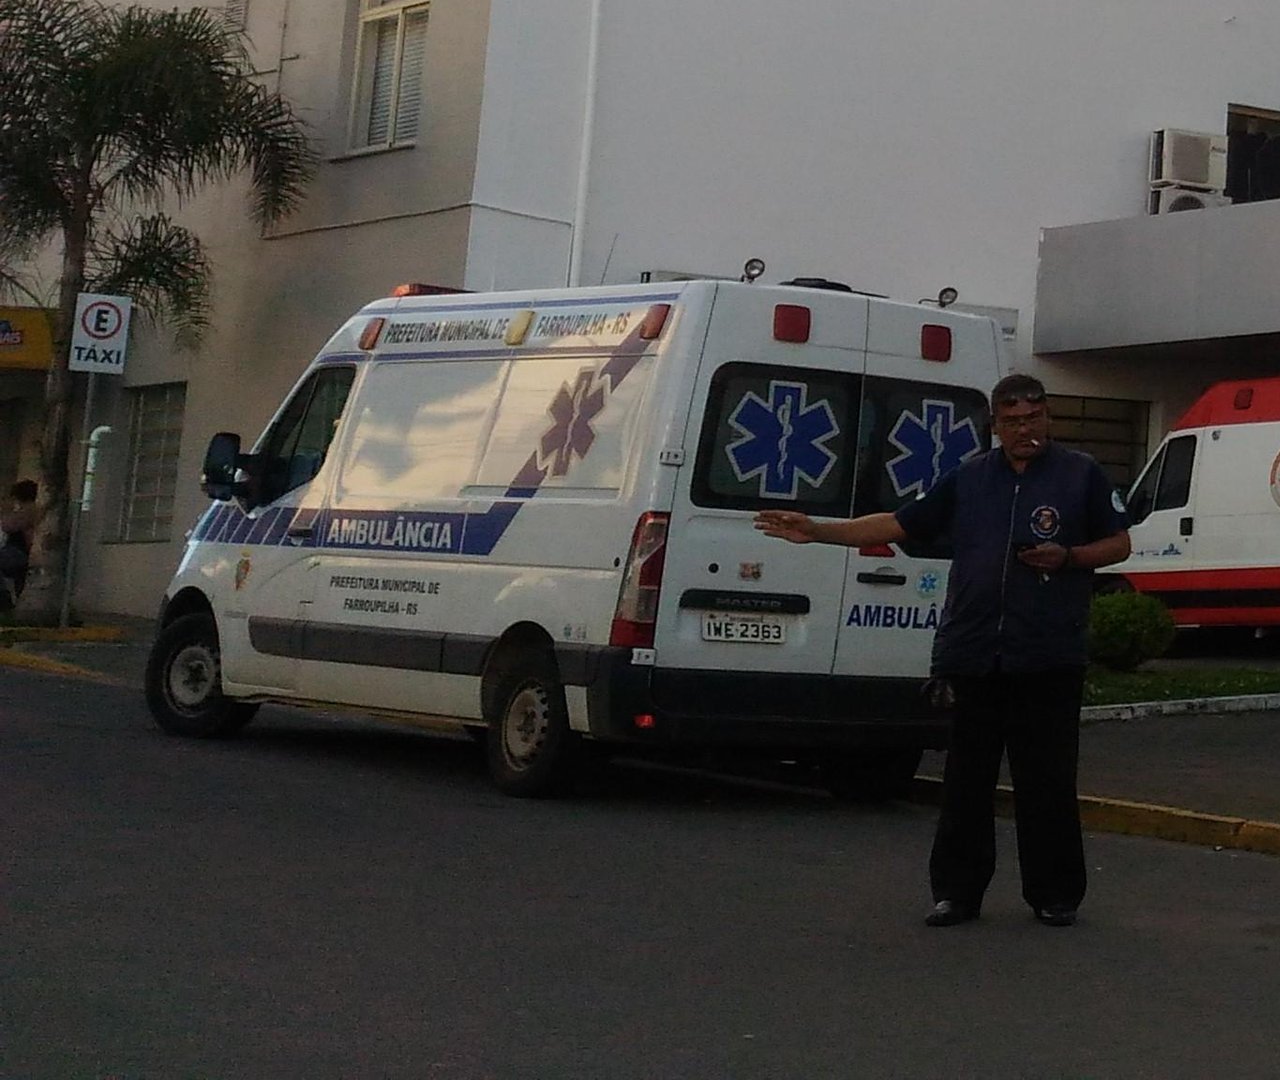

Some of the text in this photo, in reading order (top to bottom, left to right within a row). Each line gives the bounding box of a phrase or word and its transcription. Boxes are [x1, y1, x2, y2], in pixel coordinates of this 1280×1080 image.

[94, 309, 110, 332] E
[384, 322, 440, 343] PREFEITURA
[440, 319, 491, 342] MUNICIPAL
[492, 318, 510, 339] DE
[533, 313, 608, 338] FARROUPILHA
[612, 312, 631, 335] RS
[74, 344, 122, 365] TÁXI
[327, 516, 452, 548] AMBULÂNCIA
[330, 576, 441, 595] PREFEITURA MUNICIPAL DE
[343, 598, 400, 614] FARROUPILHA
[406, 603, 419, 615] RS
[846, 603, 944, 629] AMBULÂ
